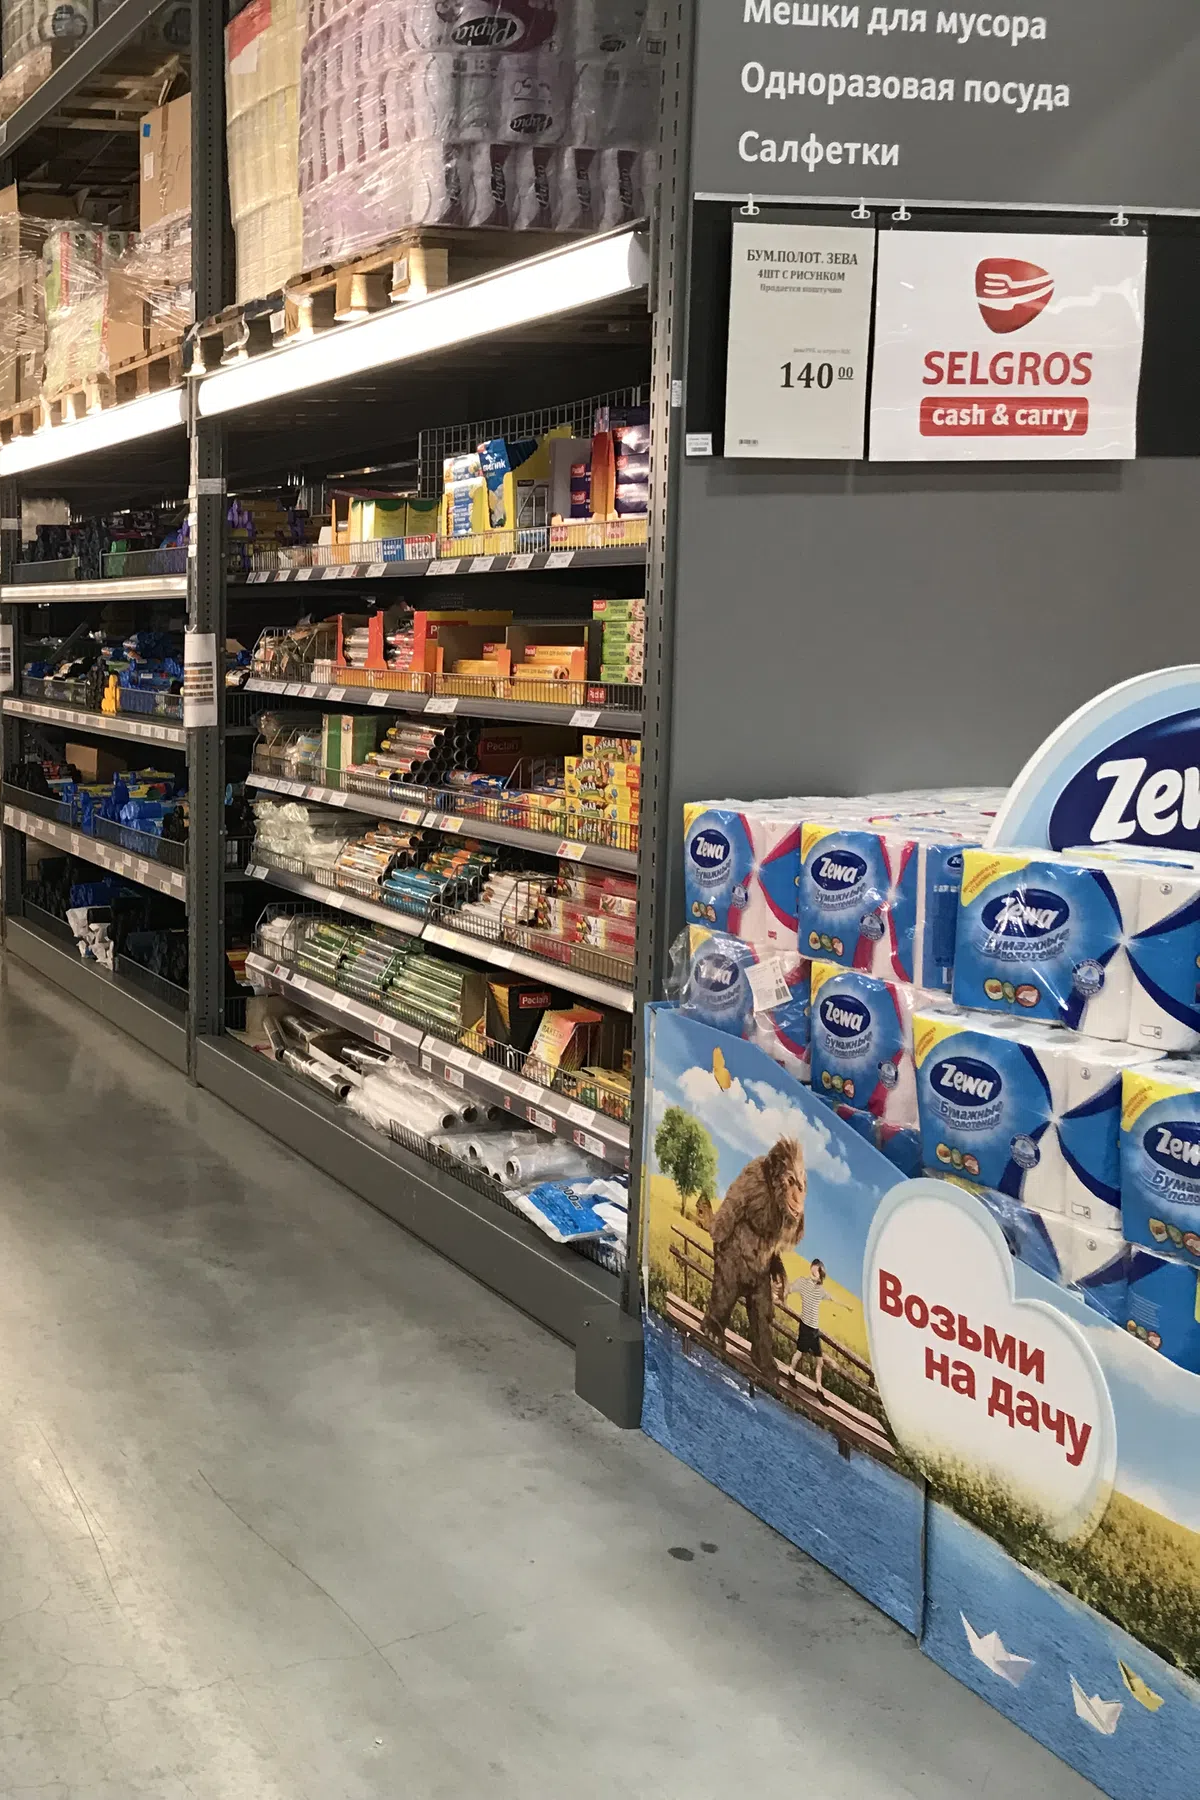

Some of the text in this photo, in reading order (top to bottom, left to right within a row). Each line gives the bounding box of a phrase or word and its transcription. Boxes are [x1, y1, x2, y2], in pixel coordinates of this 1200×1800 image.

[743, 0, 1047, 46] Мешки для мусора
[741, 61, 1070, 113] Одноразовая посуда
[738, 130, 900, 172] Салфетки
[747, 249, 858, 265] БУМ.ПОЛОТ. ЗЕВА
[757, 269, 845, 281] 4ШТ С РИСУНКОМ
[780, 362, 854, 389] 140 00
[922, 351, 1093, 386] SELGROS
[932, 403, 1078, 431] cash & carry
[486, 741, 519, 752] Paclan
[696, 837, 725, 860] Zewa
[820, 857, 859, 884] Zewa
[522, 994, 549, 1005] Paclan
[825, 1001, 864, 1031] Zewa
[939, 1063, 994, 1100] Zewa
[939, 1101, 1004, 1121] Бумажные
[879, 1268, 1045, 1385] Возьми
[925, 1346, 1092, 1467] на дачу
